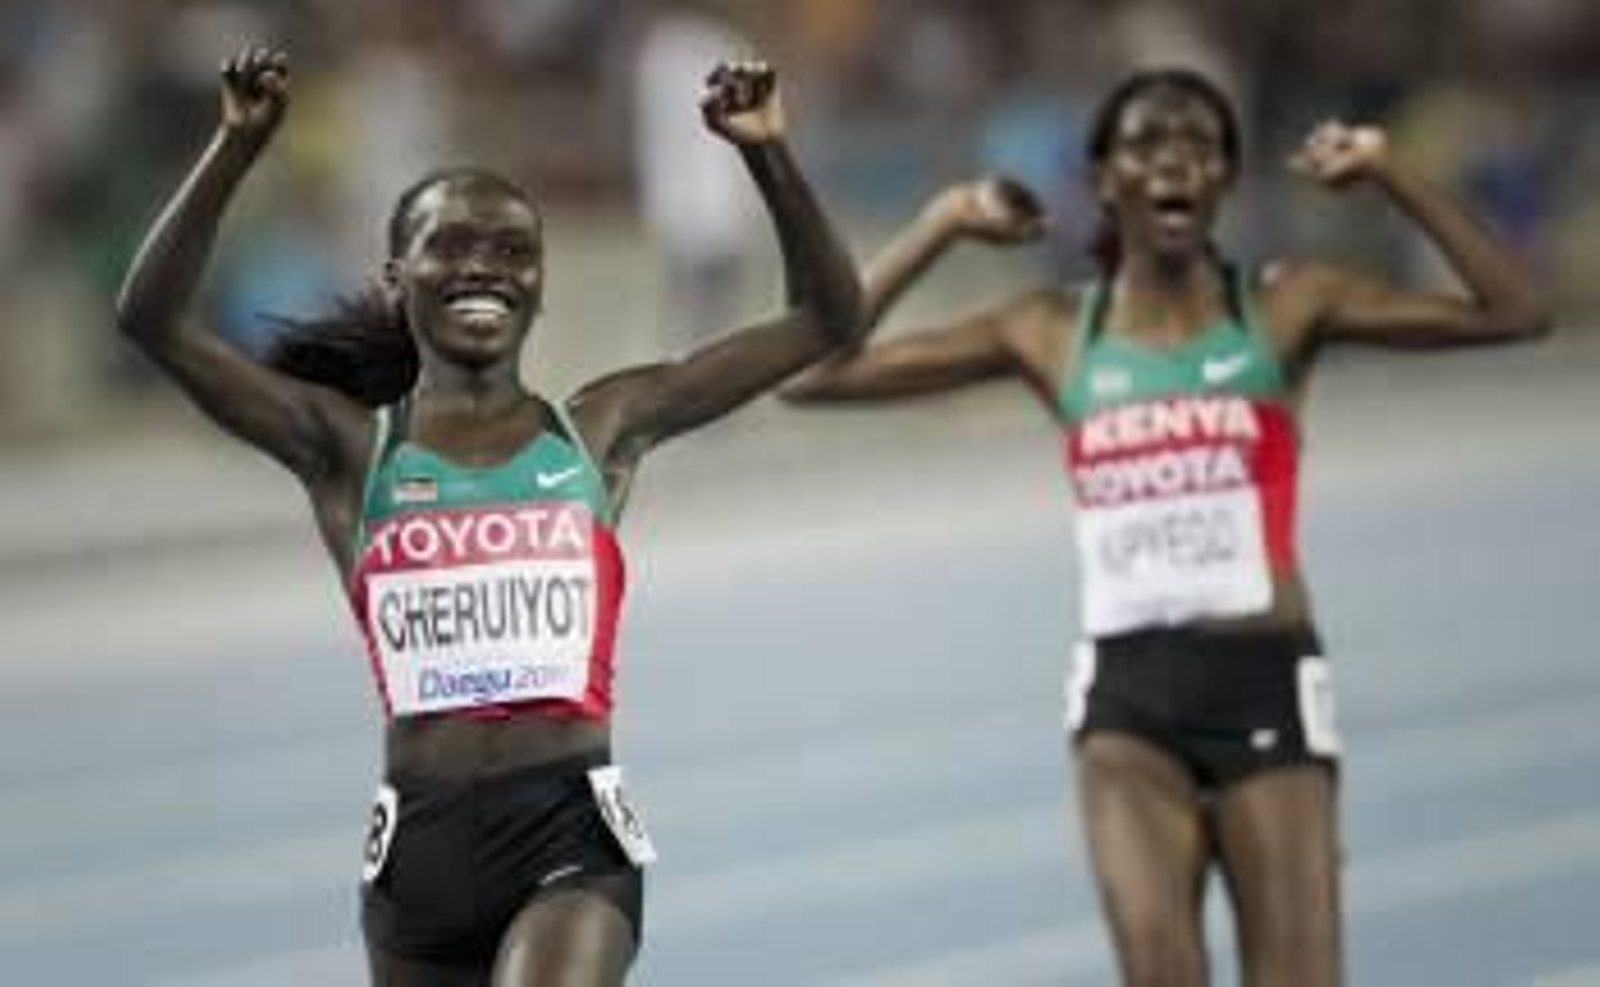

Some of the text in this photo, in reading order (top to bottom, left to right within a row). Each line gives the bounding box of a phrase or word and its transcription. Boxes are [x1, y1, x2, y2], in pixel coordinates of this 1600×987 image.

[1081, 398, 1261, 451] KENYA
[1074, 449, 1246, 505] TOYOTA
[371, 511, 585, 565] TOYOTA
[378, 575, 589, 652] CHERUIYOT
[418, 668, 511, 703] Daegu
